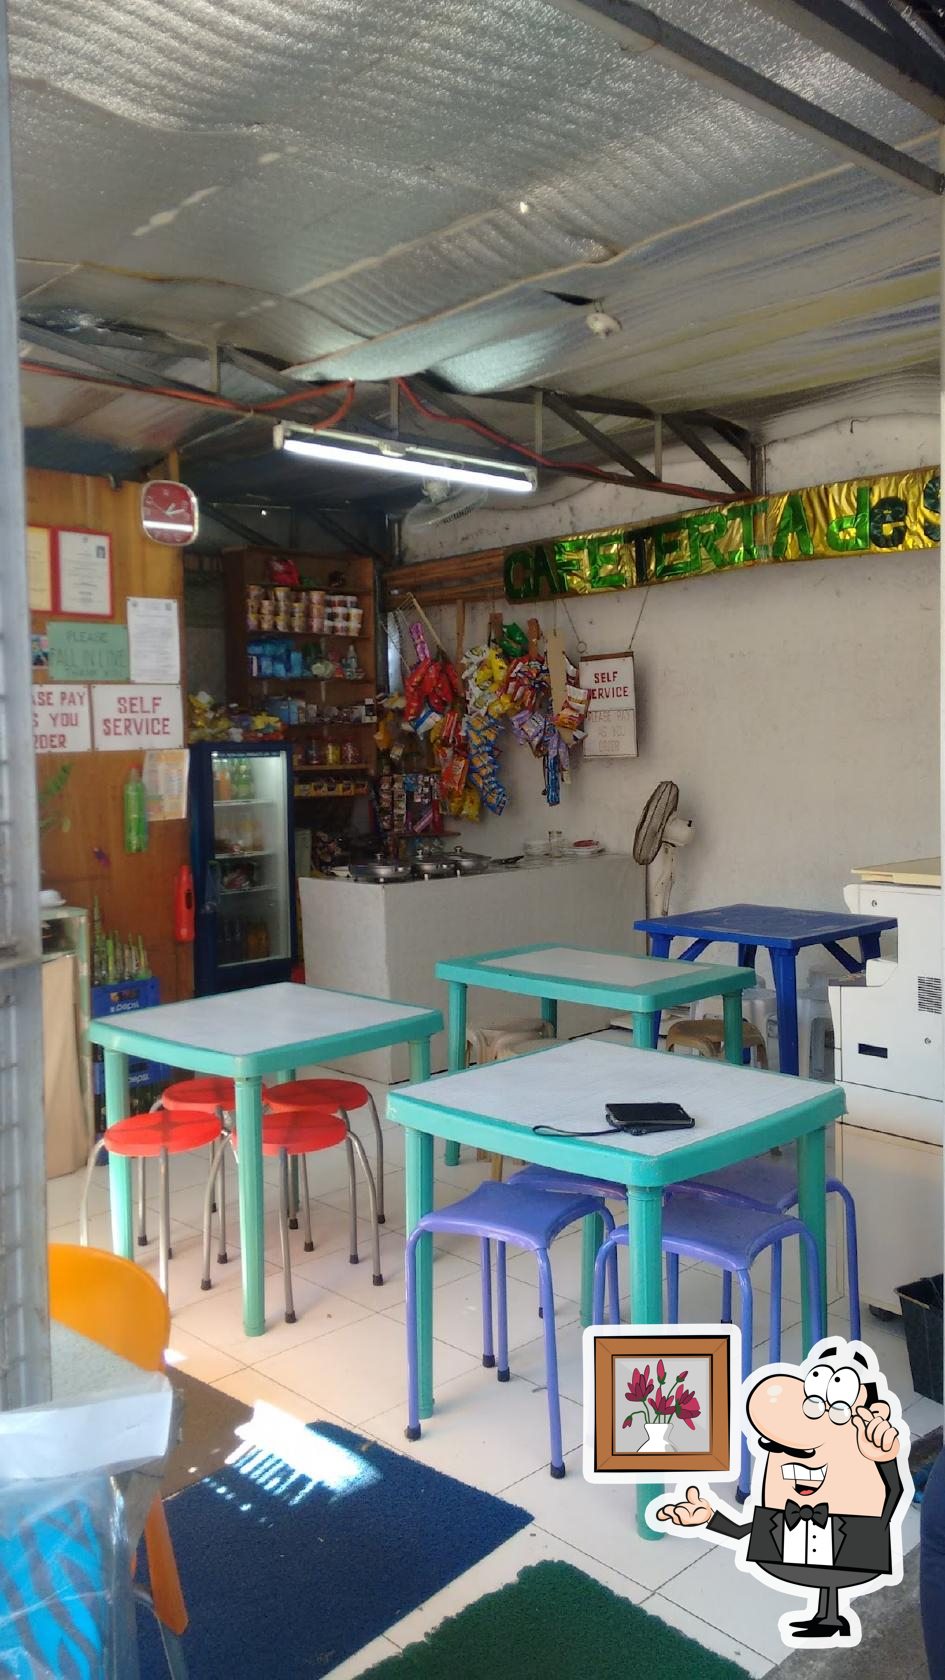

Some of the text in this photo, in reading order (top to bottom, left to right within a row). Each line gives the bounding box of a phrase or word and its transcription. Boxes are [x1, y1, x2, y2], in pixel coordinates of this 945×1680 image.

[503, 494, 815, 599] CAFETERIA
[594, 671, 618, 684] SELF
[60, 691, 86, 706] PAY
[117, 696, 162, 714] SELF
[49, 713, 79, 728] YOU
[103, 717, 171, 737] SERVICE
